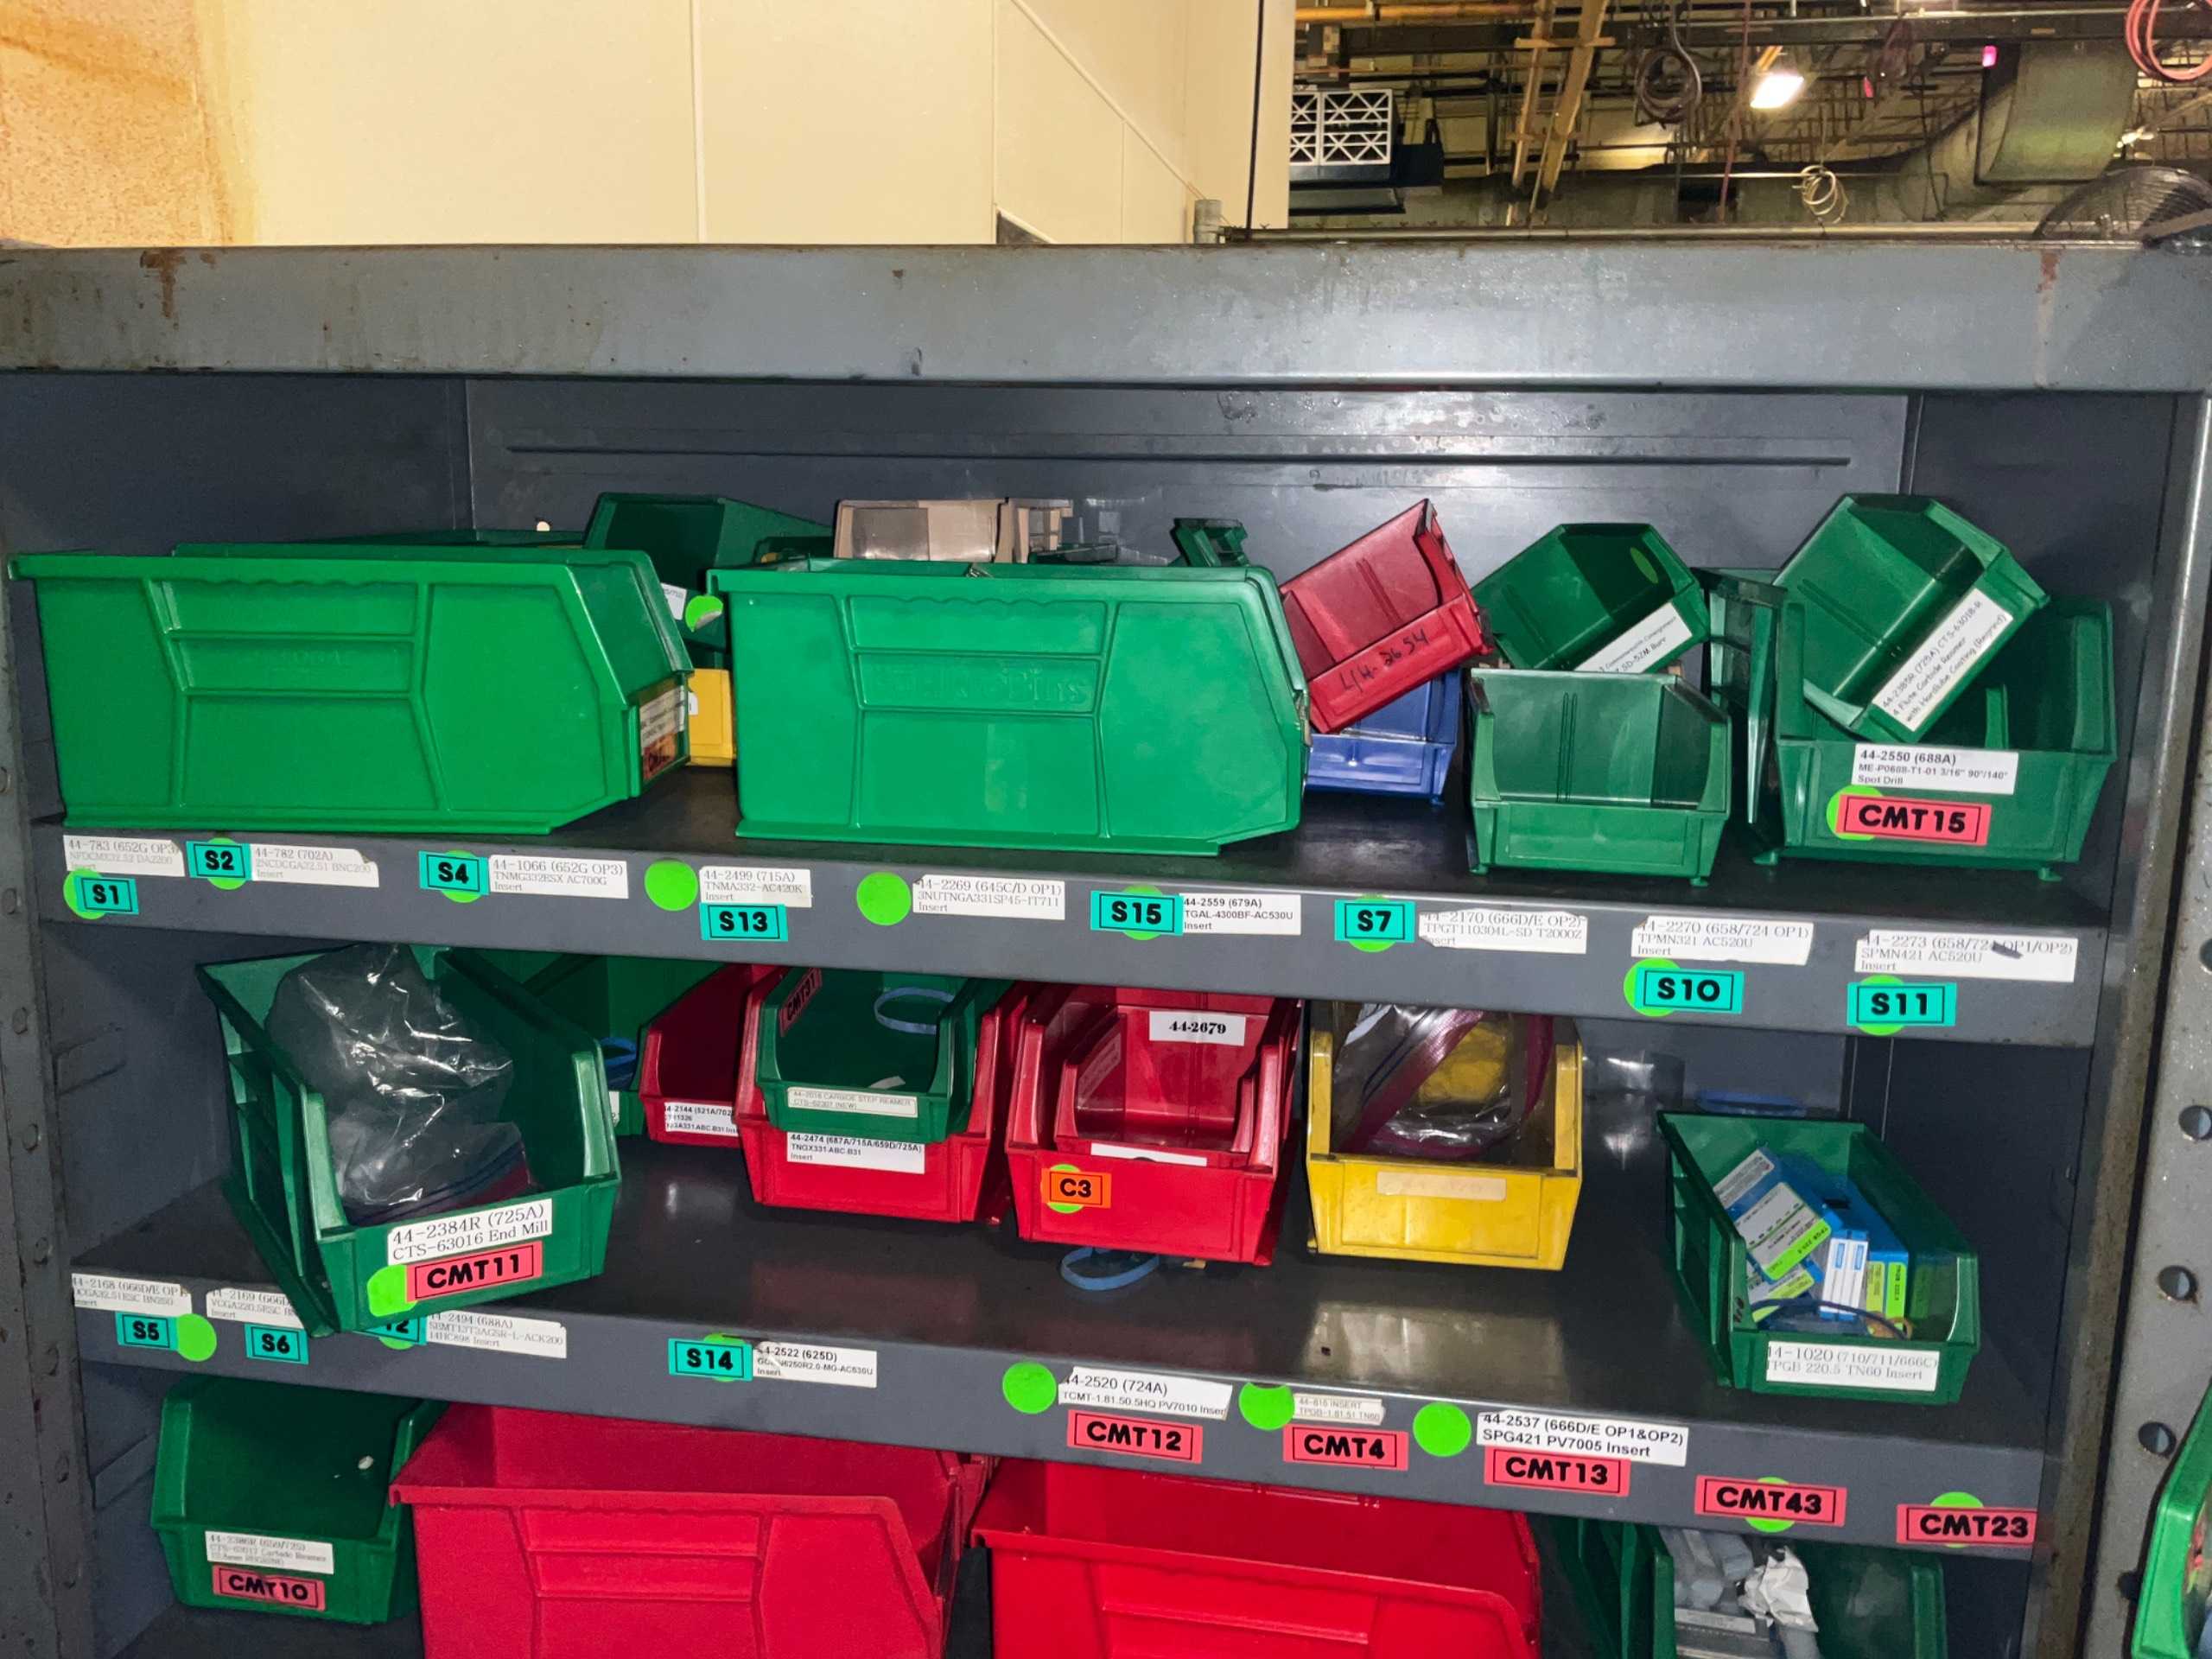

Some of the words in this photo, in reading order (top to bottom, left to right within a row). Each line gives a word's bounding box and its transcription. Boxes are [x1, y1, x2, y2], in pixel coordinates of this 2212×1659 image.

[1916, 664, 1942, 691] Carbide
[1860, 749, 1911, 762] 44-2550
[1914, 752, 1957, 766] (688A)
[1858, 775, 1881, 785] Spot
[1883, 776, 1904, 785] Drill
[1859, 804, 1967, 835] CMT15
[69, 838, 111, 852] 44-783
[255, 848, 294, 860] 44-782
[297, 849, 334, 862] (702A)
[204, 849, 235, 871] S2
[493, 858, 547, 872] 44-1066
[551, 860, 589, 874] (652G
[592, 862, 624, 876] OP3)
[437, 861, 469, 884] S4
[704, 869, 753, 882] 44-2499
[756, 870, 795, 884] (715A)
[93, 883, 119, 905] S1
[493, 881, 523, 892] Insert
[705, 893, 734, 901] Insert
[918, 901, 949, 912] Insert
[1111, 901, 1162, 926] S15
[1184, 898, 1225, 907] 44-2559
[1228, 898, 1262, 909] (679A)
[720, 911, 768, 932] S13
[1184, 921, 1212, 931] Insert
[1357, 909, 1392, 933] S7
[1637, 945, 1672, 957] Insert
[1859, 960, 1897, 972] Insert
[1656, 977, 1720, 1002] S10
[1871, 993, 1929, 1016] S11
[790, 1133, 824, 1143] 44-2474
[790, 1152, 813, 1161] Insert
[1059, 1178, 1093, 1199] C3
[393, 1215, 481, 1245] 44-2384R
[487, 1203, 545, 1228] (725A)
[393, 1230, 484, 1262] CTS-63016
[489, 1224, 518, 1243] End
[522, 1218, 549, 1236] Mill
[427, 1253, 520, 1290] CMT11
[132, 1322, 160, 1341] S5
[261, 1333, 290, 1354] S6
[686, 1348, 734, 1371] S14
[802, 1348, 838, 1363] (625D)
[1847, 1365, 1882, 1377] TN60
[1885, 1367, 1924, 1381] Insert
[1122, 1378, 1168, 1397] (724A)
[1086, 1421, 1182, 1452] CMT12
[1482, 1414, 1541, 1430] 44-2537
[1543, 1416, 1601, 1436] (666D/E
[1604, 1425, 1684, 1448] OP1&OP2)
[1303, 1435, 1386, 1459] CMT4
[1482, 1433, 1541, 1446] SPG421
[1547, 1437, 1602, 1452] PV7005
[1606, 1443, 1651, 1458] Insert
[1505, 1456, 1609, 1485] CMT13
[1716, 1485, 1823, 1515] CMT43
[1920, 1514, 2029, 1539] CMT23
[228, 1573, 309, 1602] CMT10
